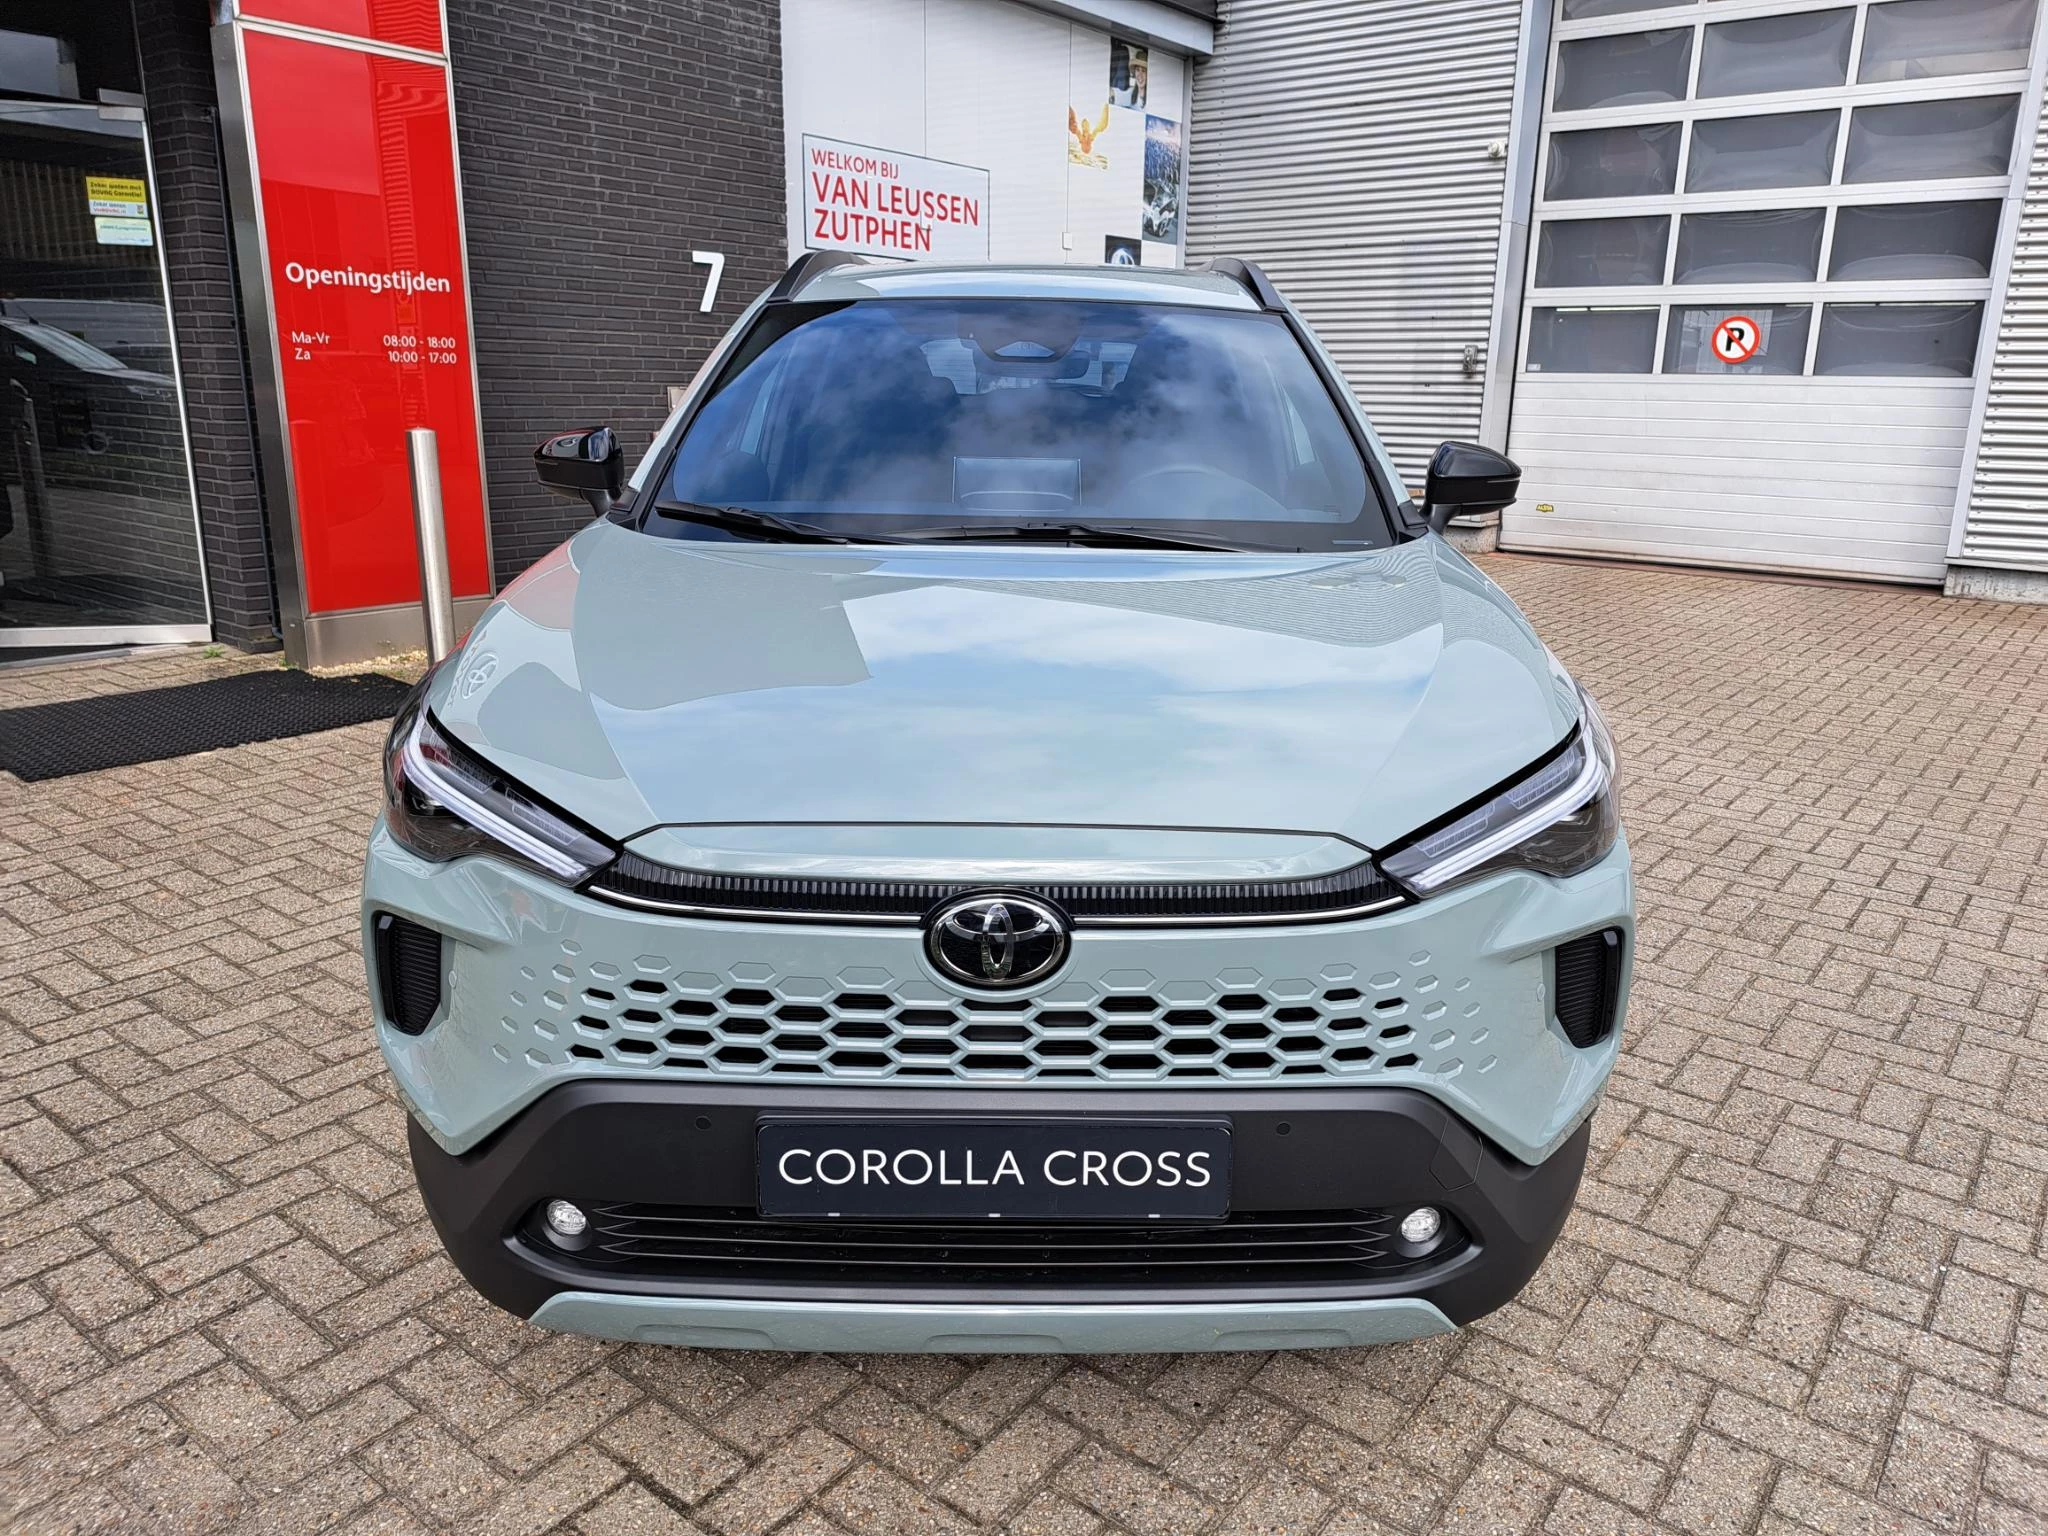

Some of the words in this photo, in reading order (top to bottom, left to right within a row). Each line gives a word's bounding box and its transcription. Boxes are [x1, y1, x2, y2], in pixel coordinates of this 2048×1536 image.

[812, 148, 877, 176] WELKOM
[881, 161, 899, 179] BIJ
[812, 171, 869, 209] VAN
[877, 183, 979, 226] LEUSSEN
[814, 208, 931, 251] ZUTPHEN
[285, 262, 451, 296] Openingstijden
[692, 250, 725, 312] 7
[291, 331, 331, 345] Ma-Vr
[383, 334, 417, 347] 08:00
[427, 336, 456, 349] 18:00
[295, 347, 311, 361] Za
[388, 350, 418, 363] 10:00
[429, 352, 457, 364] 17:00
[778, 1148, 1026, 1186] COROLLA
[1043, 1150, 1212, 1188] CROSS
